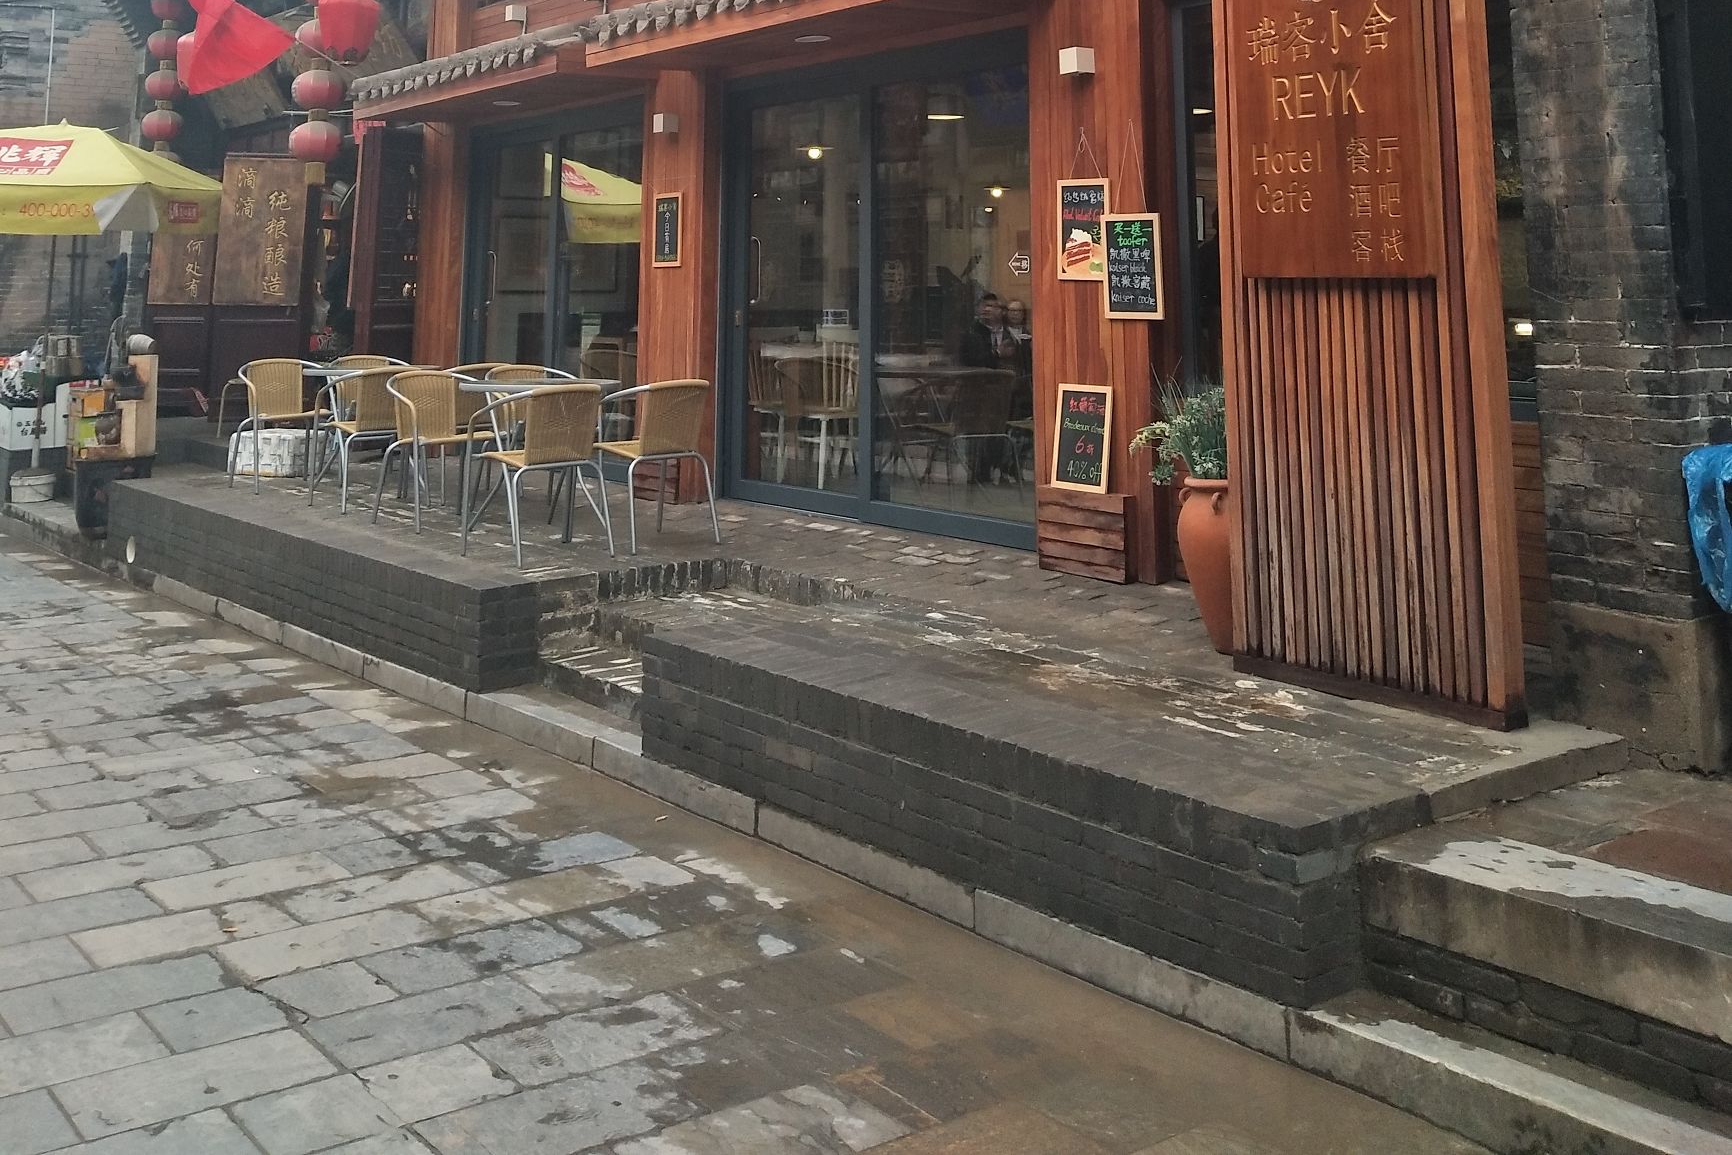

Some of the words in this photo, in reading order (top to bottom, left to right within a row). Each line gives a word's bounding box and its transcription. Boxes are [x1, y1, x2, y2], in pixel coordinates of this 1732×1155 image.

[1271, 67, 1366, 121] REYK
[1252, 139, 1323, 176] Hotel
[1346, 136, 1400, 175] 餐厅
[19, 202, 95, 219] 400-000-3
[235, 168, 258, 219] 滴滴
[1255, 179, 1313, 214] Café
[1350, 181, 1402, 218] 酒吧
[261, 190, 292, 296] 纯粮酿造
[1113, 221, 1153, 236] 买一送一
[1117, 234, 1148, 247] toofer
[1351, 228, 1405, 263] 客栈
[1067, 458, 1088, 480] 40%
